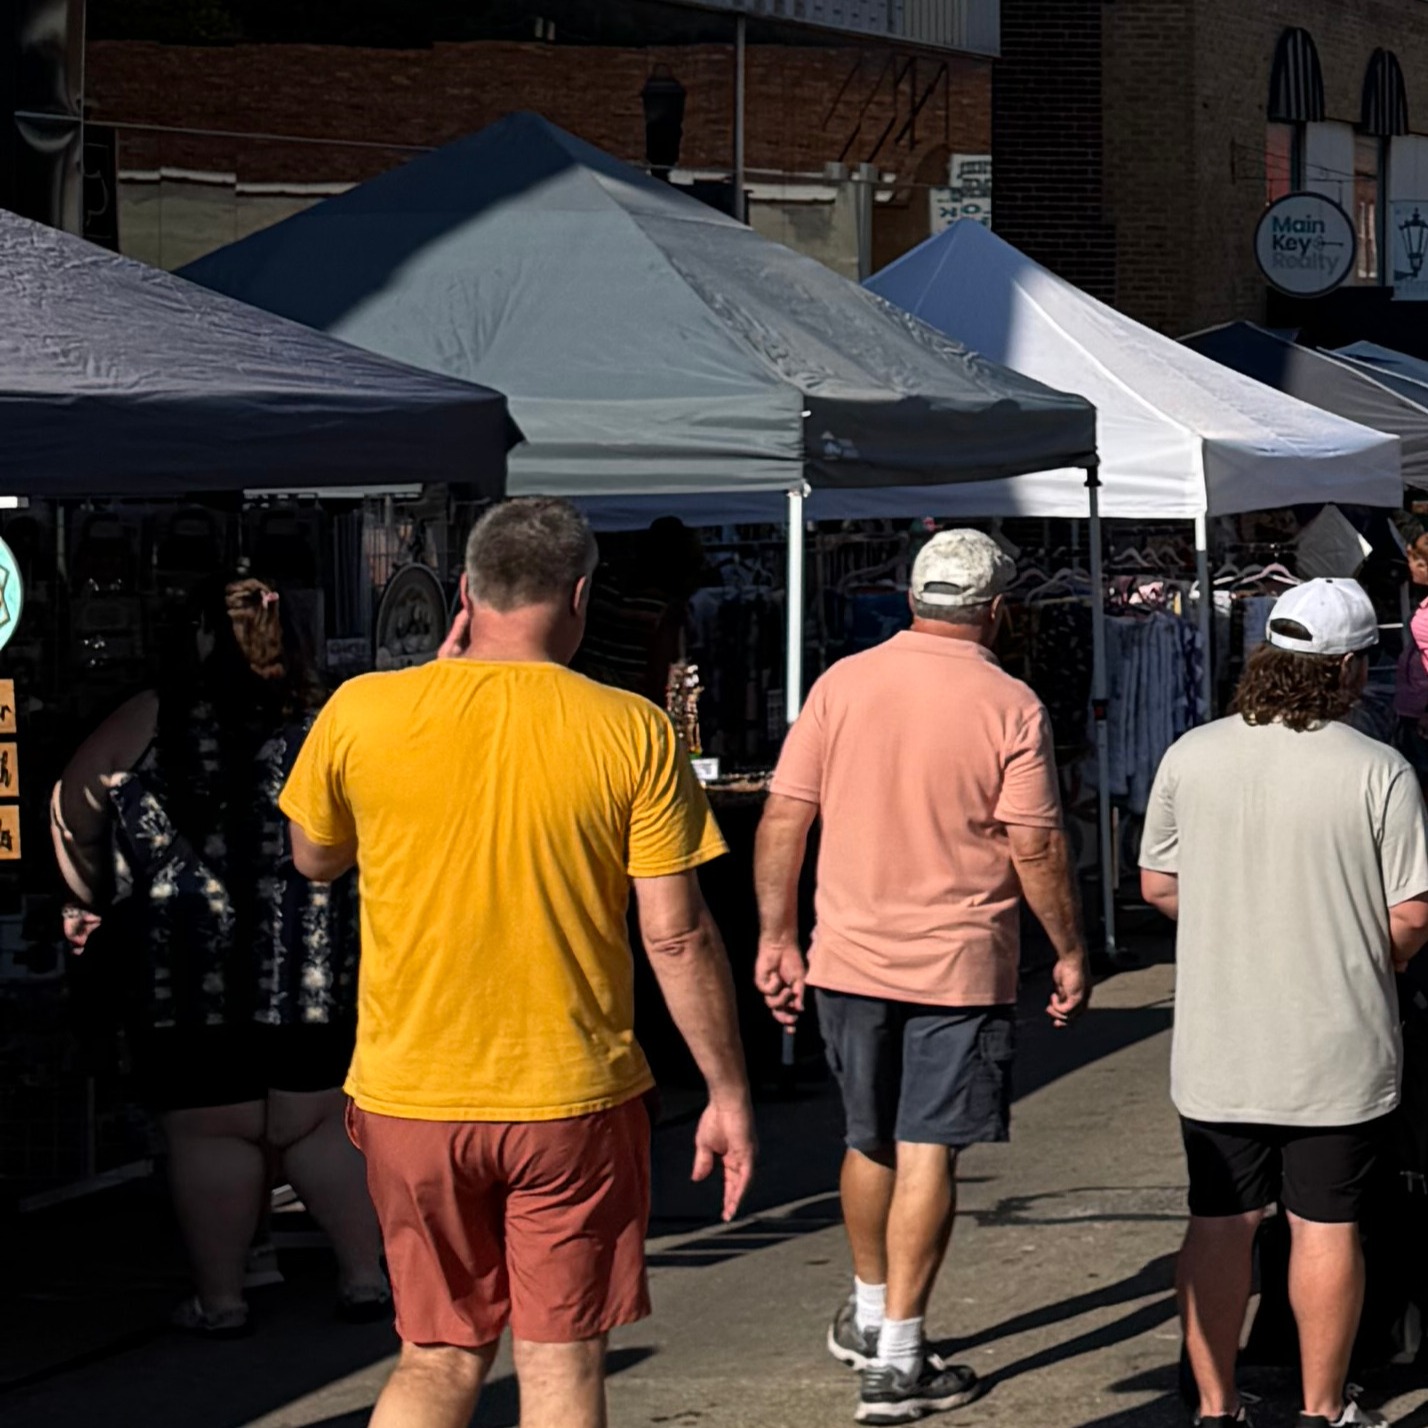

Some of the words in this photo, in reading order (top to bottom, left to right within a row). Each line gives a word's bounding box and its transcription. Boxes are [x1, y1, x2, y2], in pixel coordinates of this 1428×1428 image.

[1272, 215, 1325, 233] Main
[1272, 235, 1313, 257] Key
[1272, 253, 1340, 276] Realty
